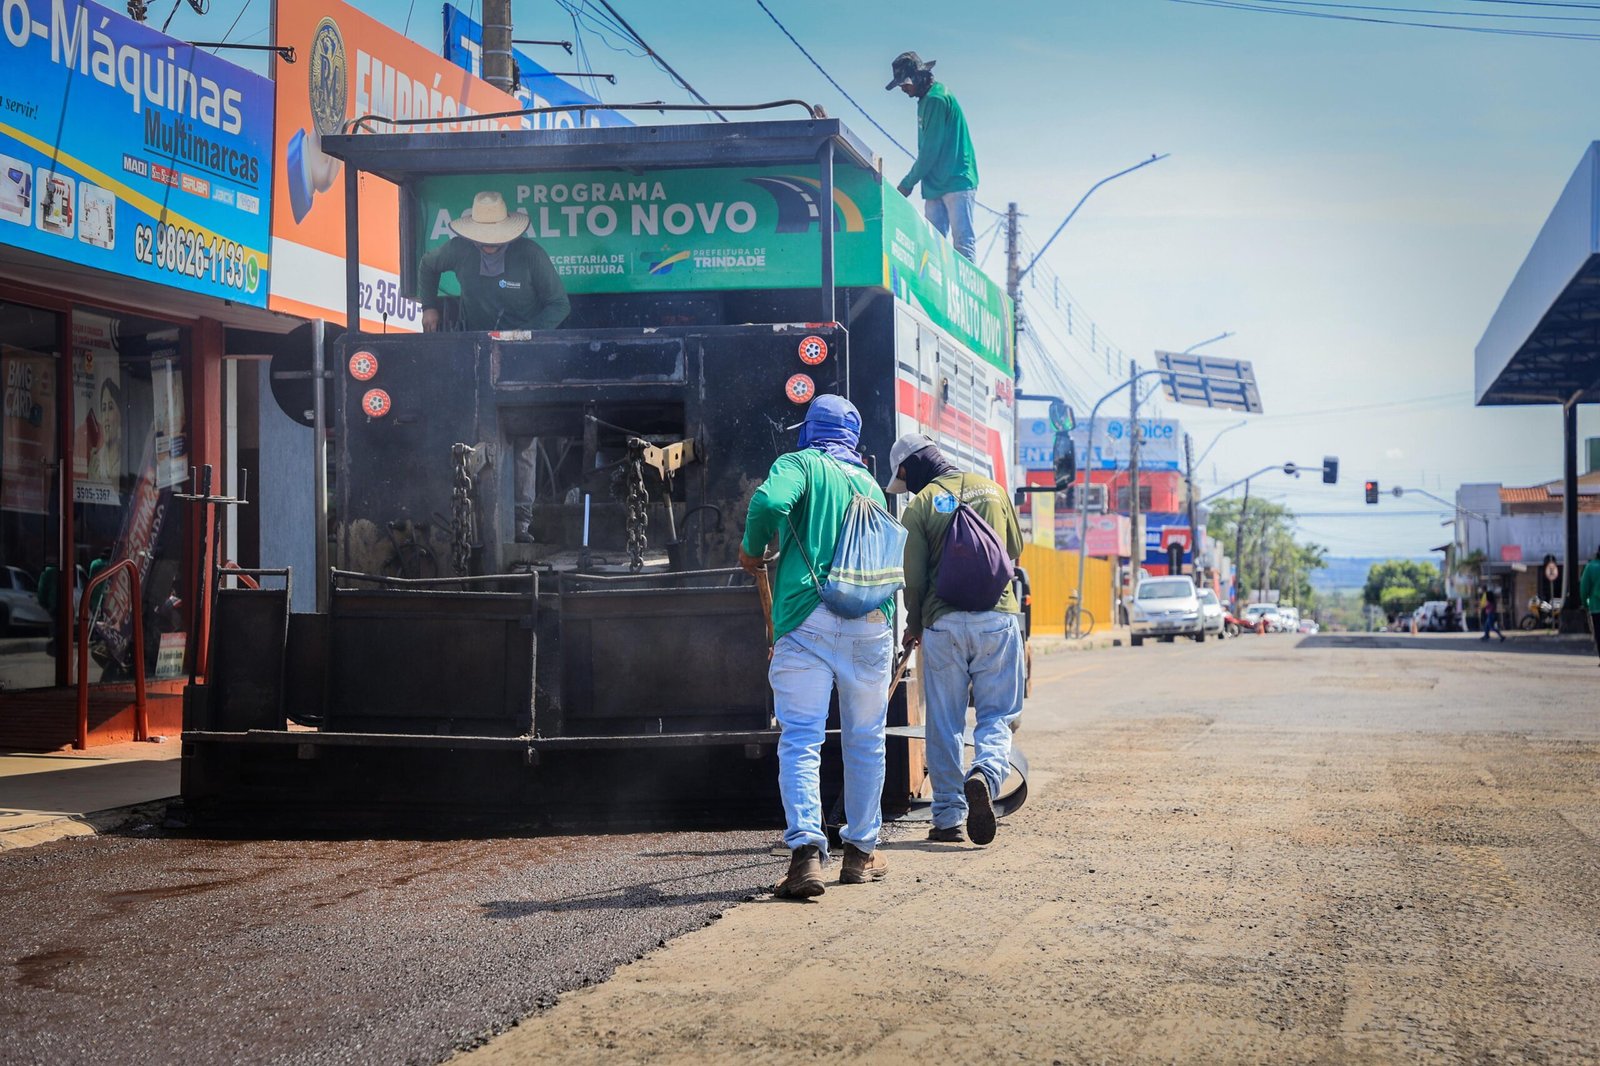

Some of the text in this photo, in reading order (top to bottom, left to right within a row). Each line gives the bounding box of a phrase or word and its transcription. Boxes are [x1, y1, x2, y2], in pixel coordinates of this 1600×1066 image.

[5, 97, 39, 120] servir!
[144, 107, 259, 184] Multimarcas
[517, 182, 667, 204] PROGRAMA
[430, 201, 757, 240] AALTO NOVO
[135, 222, 245, 290] 62 98626-1133
[549, 254, 625, 265] ECRETARIA DE
[693, 248, 751, 257] PREFEITURA
[693, 256, 766, 267] TRINDADE
[359, 282, 373, 311] 62
[980, 304, 1001, 358] NOVO
[8, 359, 33, 393] BMG
[3, 386, 33, 420] CARD
